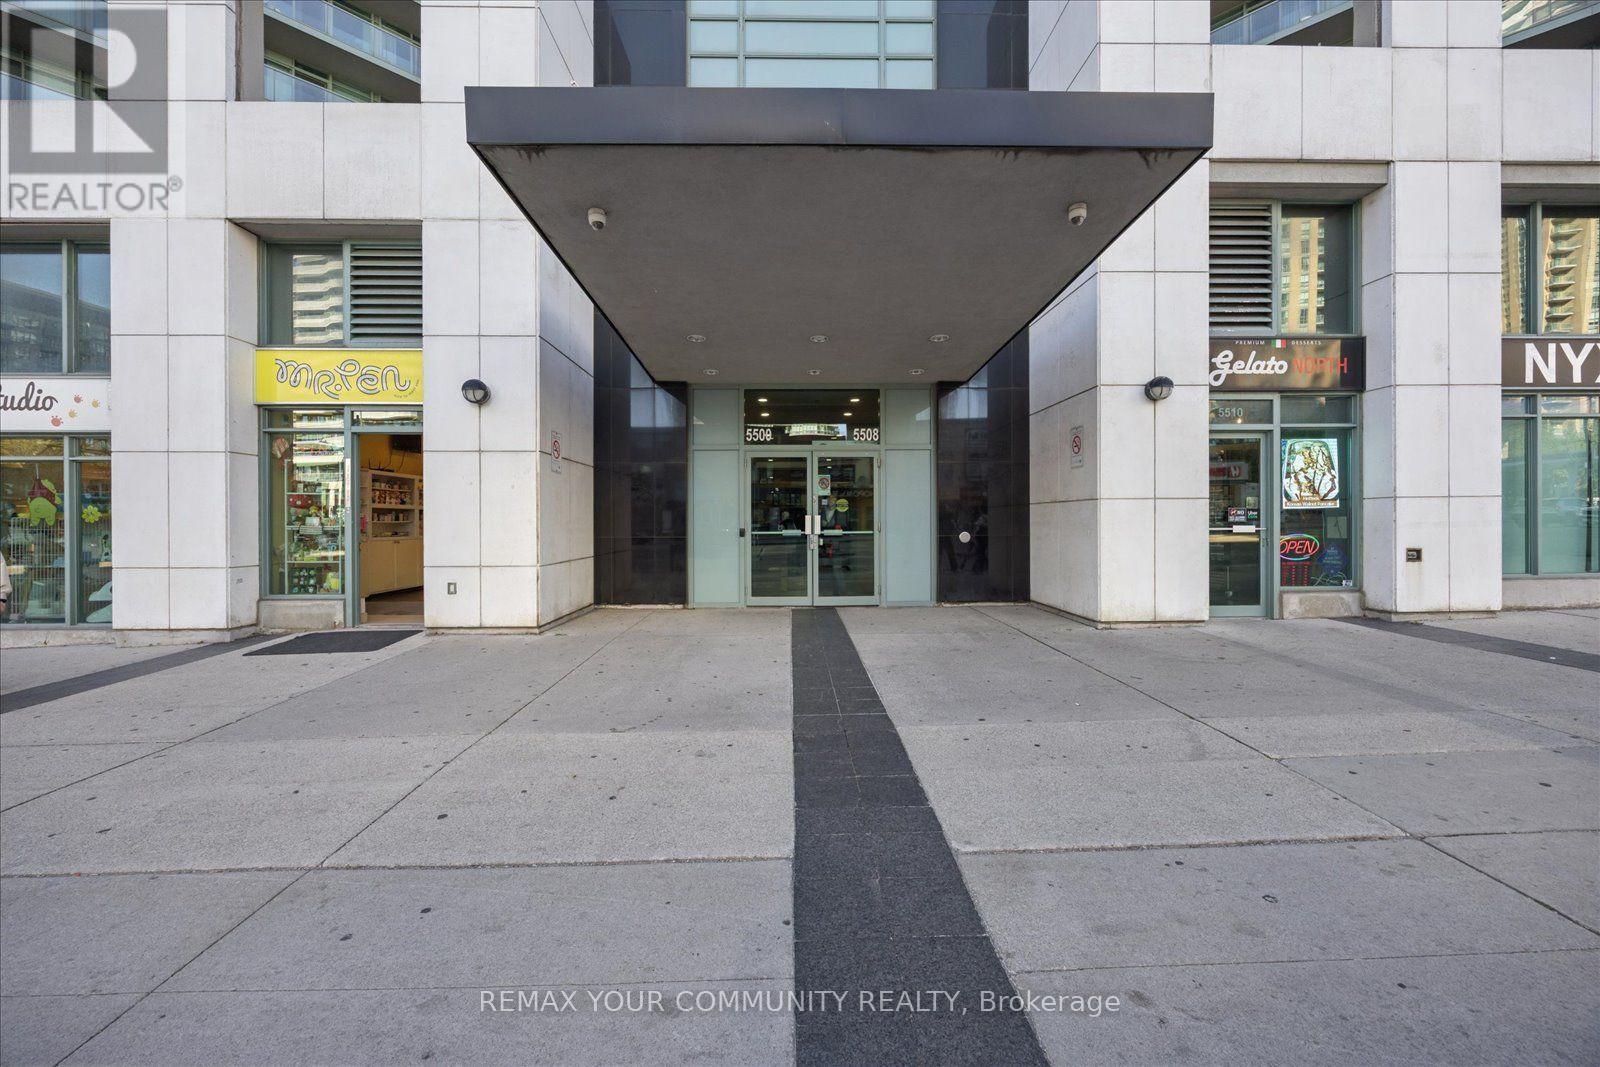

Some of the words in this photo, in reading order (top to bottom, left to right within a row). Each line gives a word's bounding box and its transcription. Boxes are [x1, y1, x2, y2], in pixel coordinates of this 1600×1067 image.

[1209, 349, 1288, 387] Gelato
[1293, 357, 1348, 373] NORTH
[1525, 343, 1600, 383] NY
[1218, 407, 1243, 417] 5510
[853, 427, 879, 441] 5508
[1280, 540, 1315, 554] OPEN
